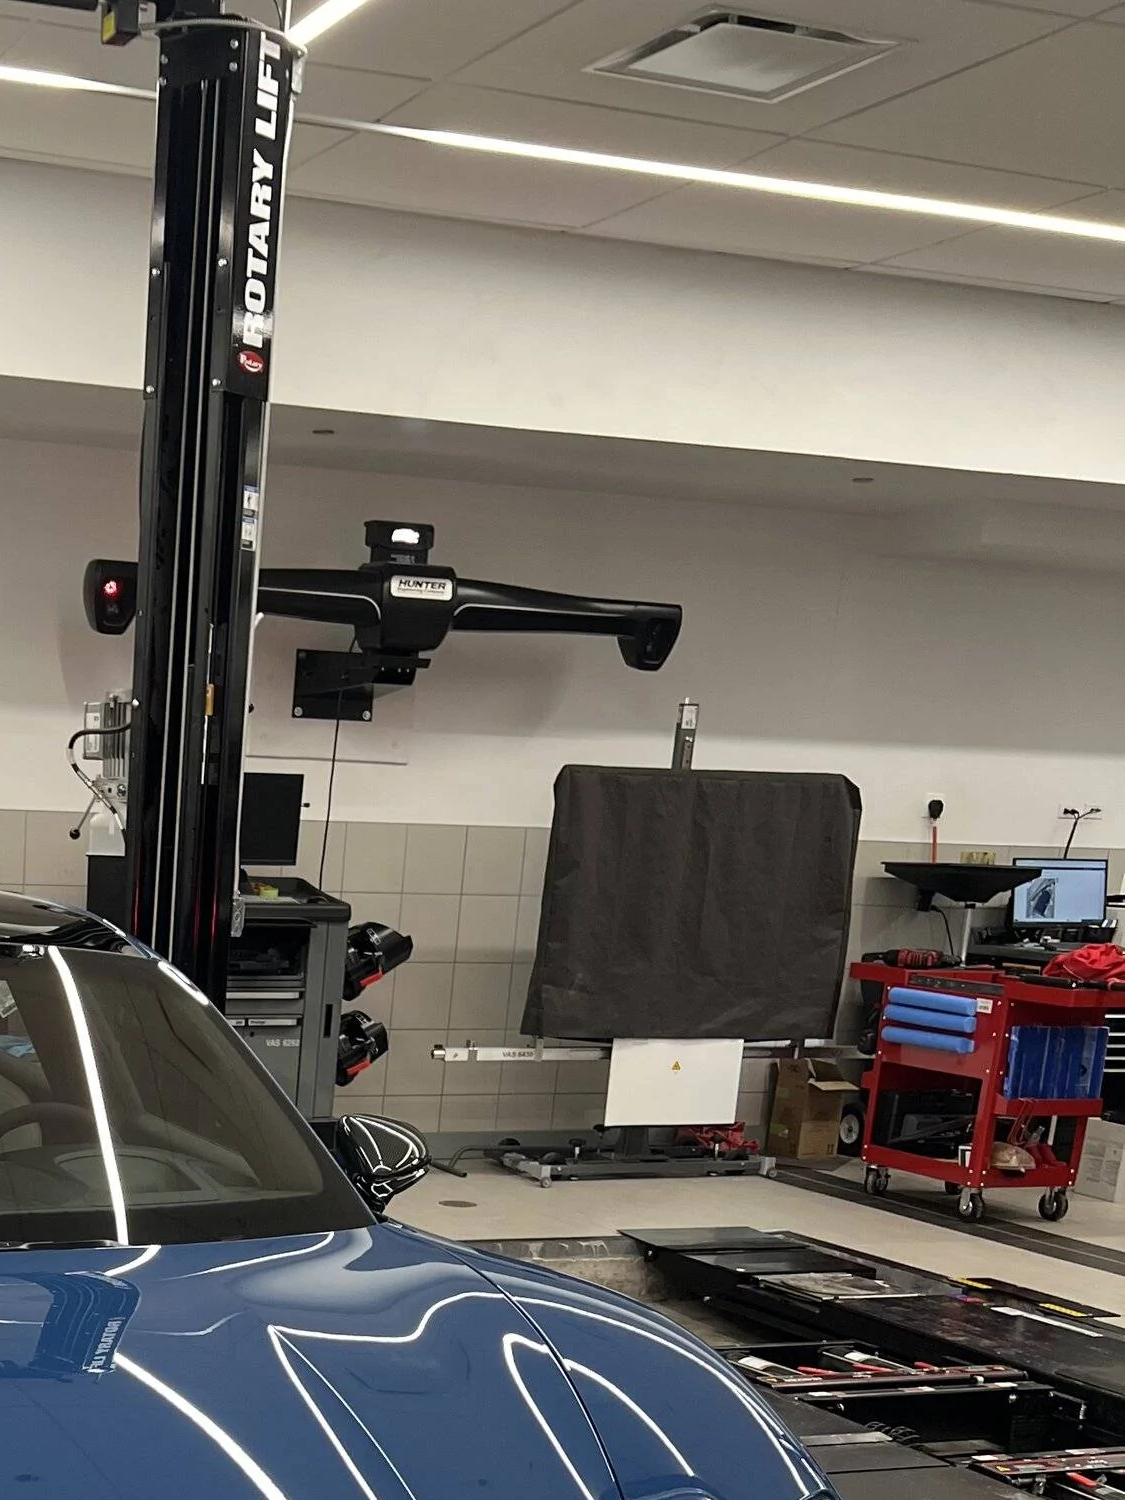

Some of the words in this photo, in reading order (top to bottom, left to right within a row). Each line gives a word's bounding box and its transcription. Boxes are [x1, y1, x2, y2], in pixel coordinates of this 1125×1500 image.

[255, 31, 281, 140] LIFT
[243, 148, 274, 348] ROTARY
[399, 579, 446, 590] HUNTER
[266, 1039, 280, 1047] VAS
